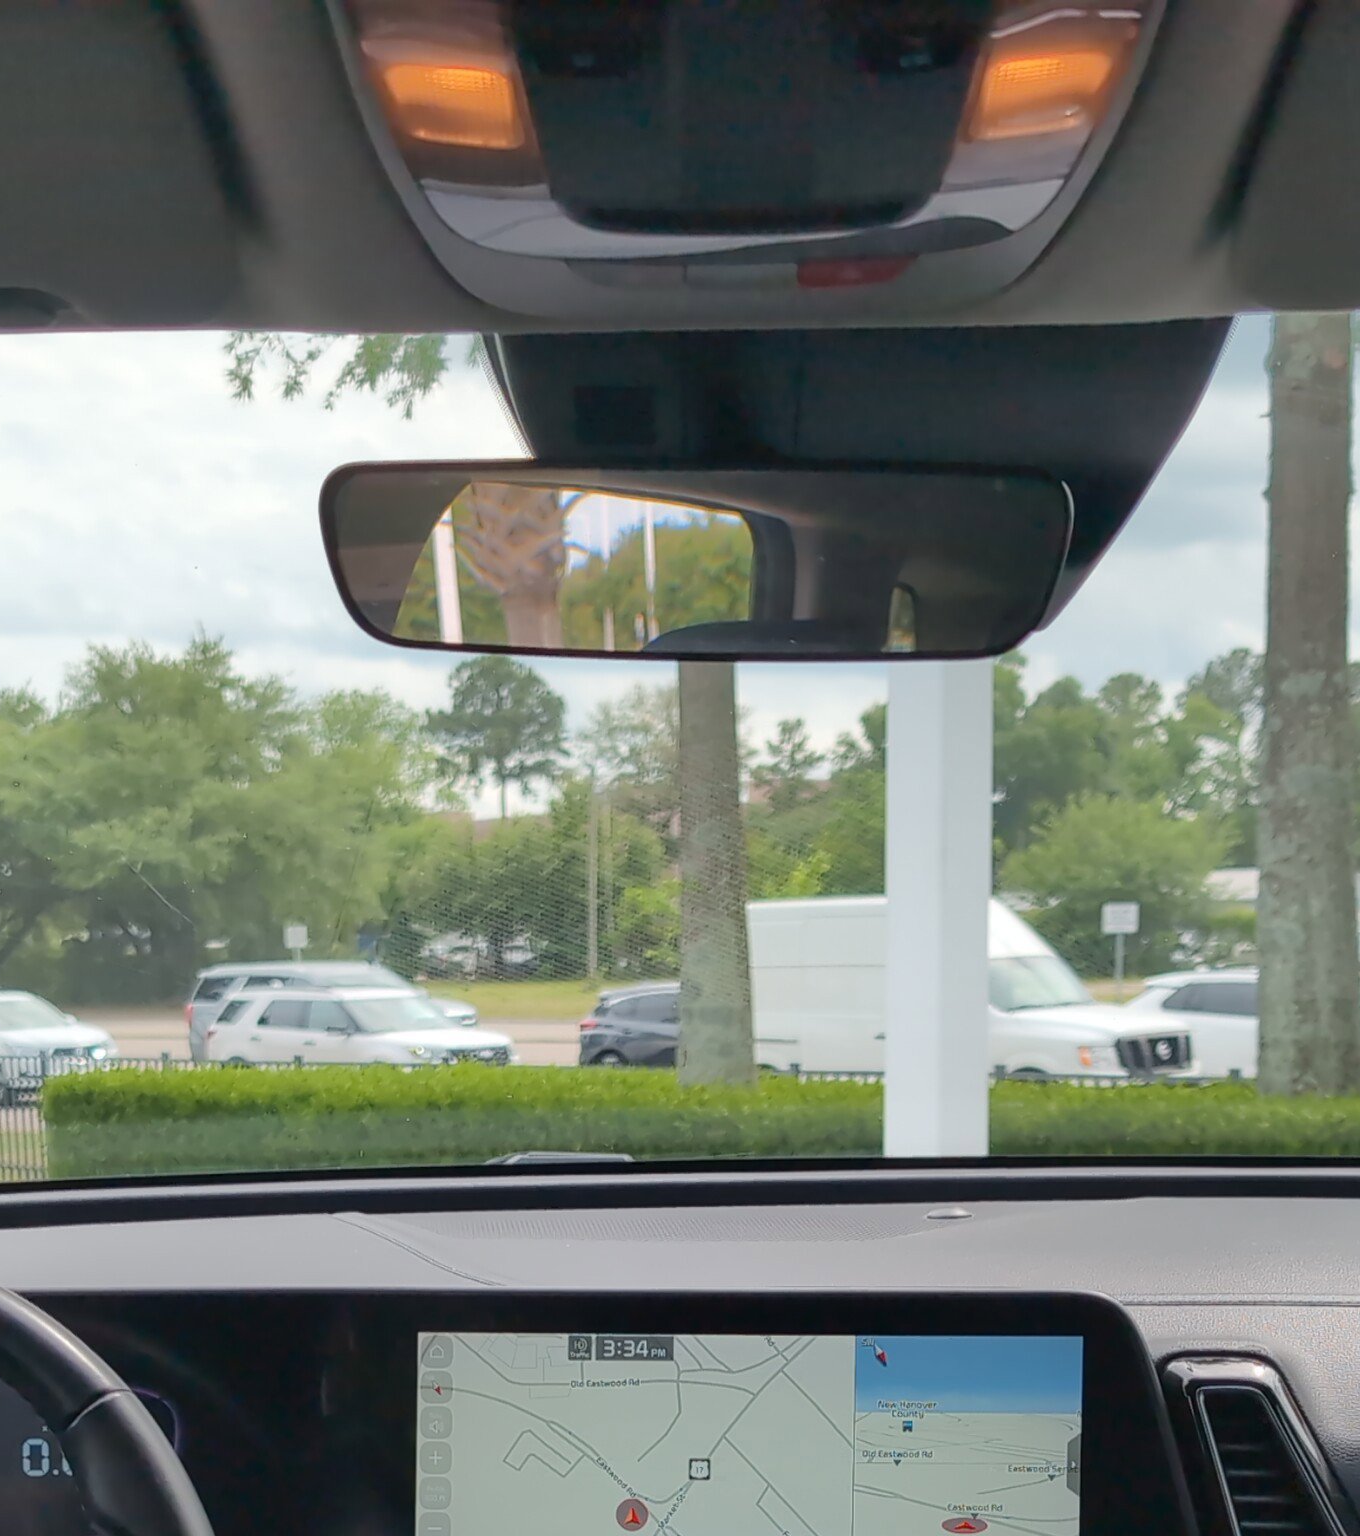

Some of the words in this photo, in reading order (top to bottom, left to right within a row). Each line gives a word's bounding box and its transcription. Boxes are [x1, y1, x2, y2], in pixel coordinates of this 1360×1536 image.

[603, 1339, 649, 1358] 3:34
[651, 1348, 666, 1358] PM
[570, 1380, 585, 1388] Old
[586, 1379, 627, 1388] Eastwood
[628, 1378, 640, 1387] Rd
[877, 1400, 896, 1409] New
[899, 1400, 937, 1409] Hanover
[891, 1410, 925, 1419] County
[862, 1450, 876, 1459] Old
[878, 1450, 920, 1459] Eastwood
[922, 1450, 933, 1458] Rd
[596, 1456, 629, 1489] Eastwood
[1008, 1464, 1050, 1474] Eastwood
[948, 1504, 990, 1512] Eastwood
[992, 1503, 1003, 1512] Rd
